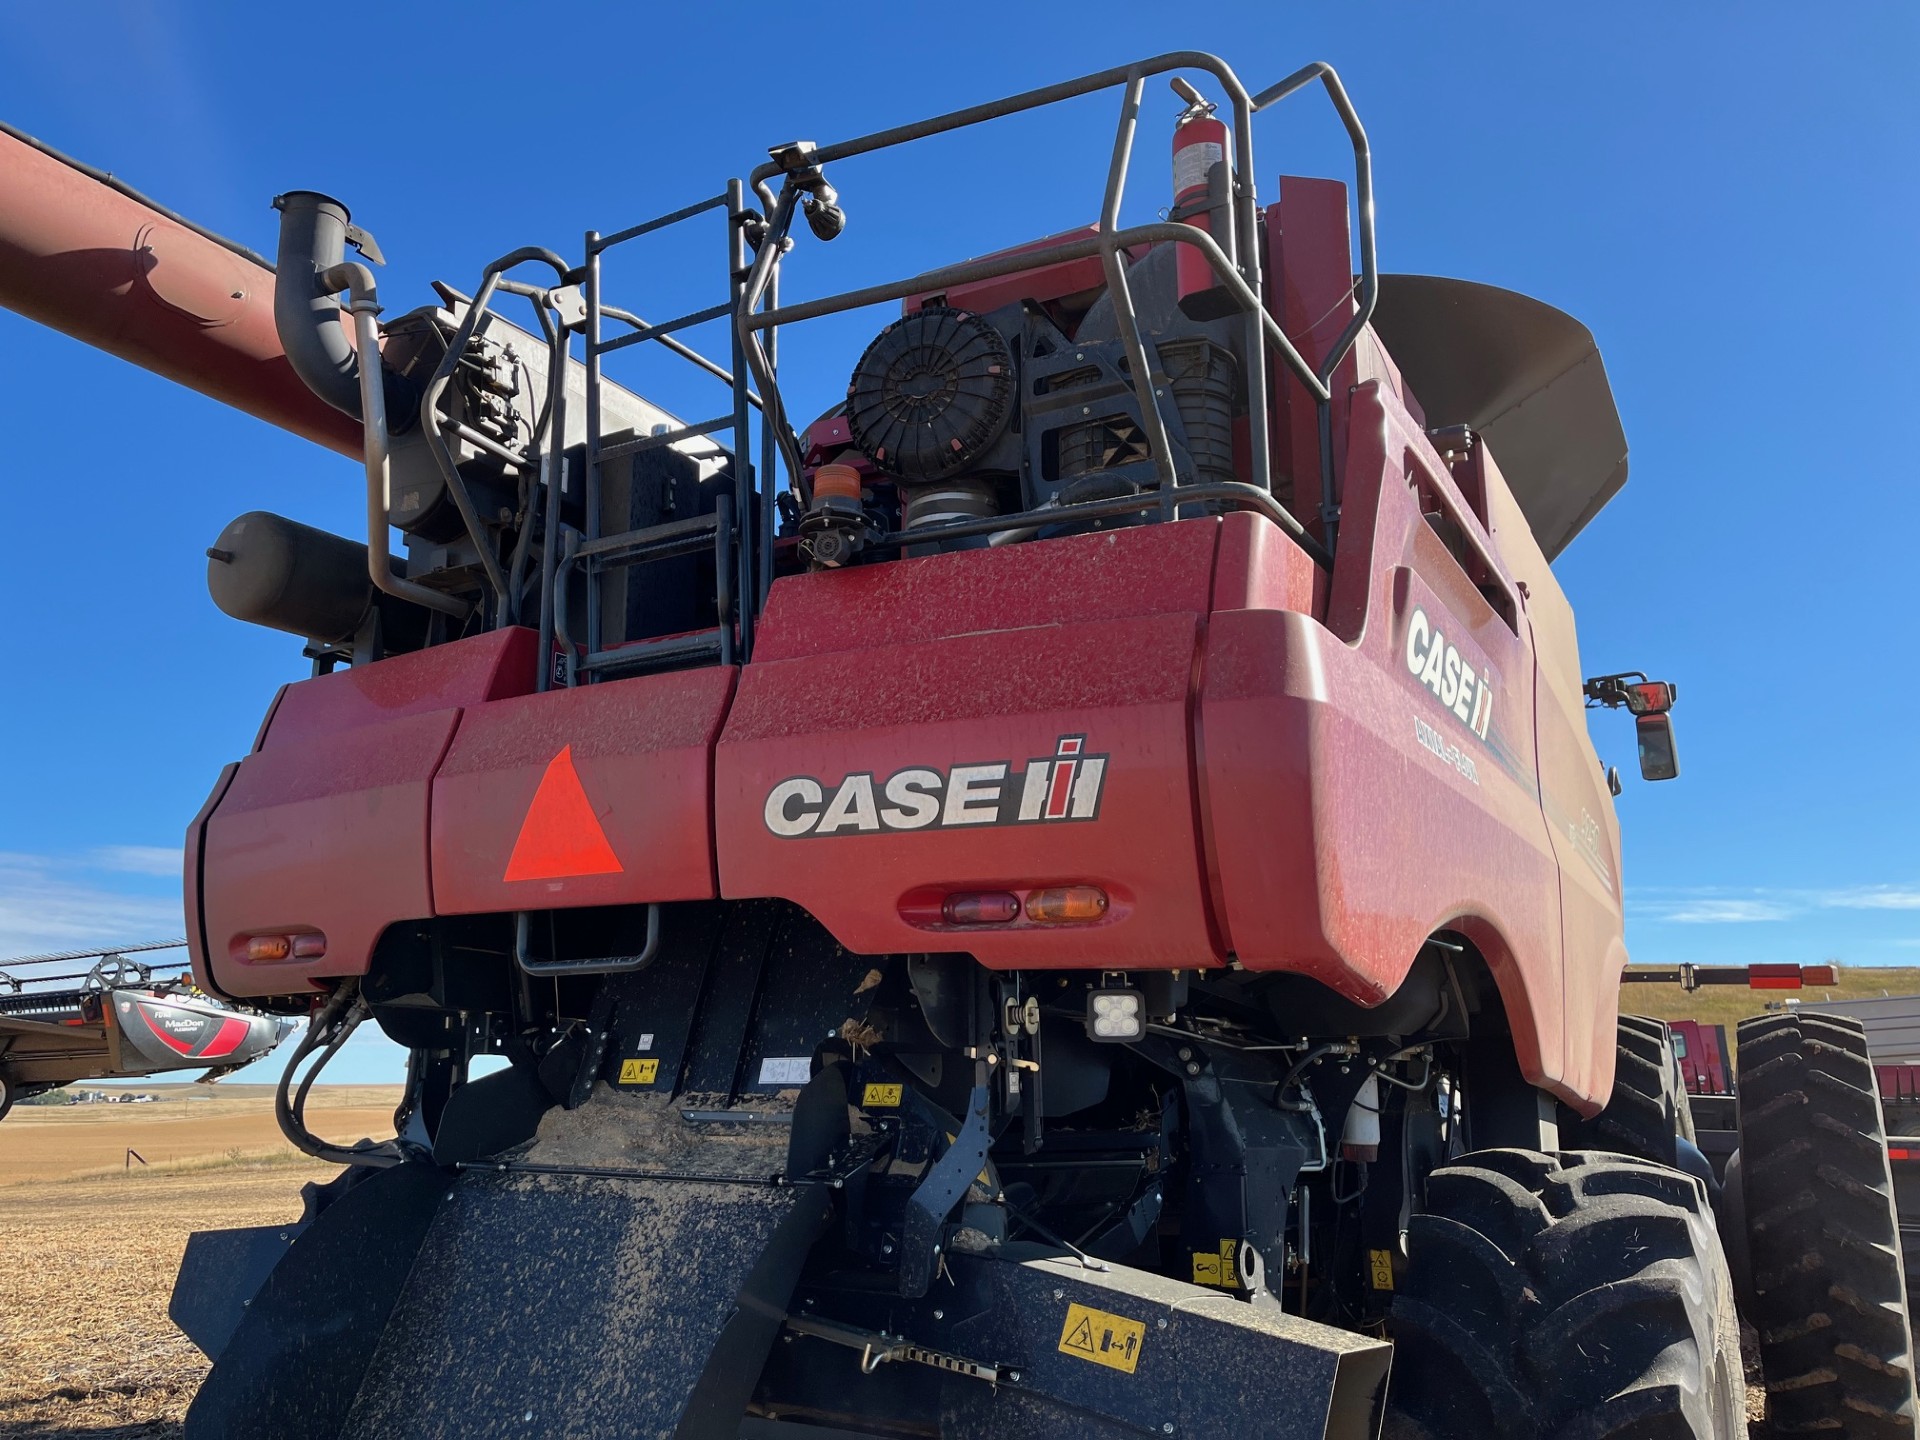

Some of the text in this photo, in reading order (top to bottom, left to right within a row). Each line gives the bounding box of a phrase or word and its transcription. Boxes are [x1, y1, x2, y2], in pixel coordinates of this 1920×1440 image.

[1407, 609, 1475, 723] CASE
[764, 737, 1106, 837] CASE IH
[165, 1019, 204, 1028] MacDon
